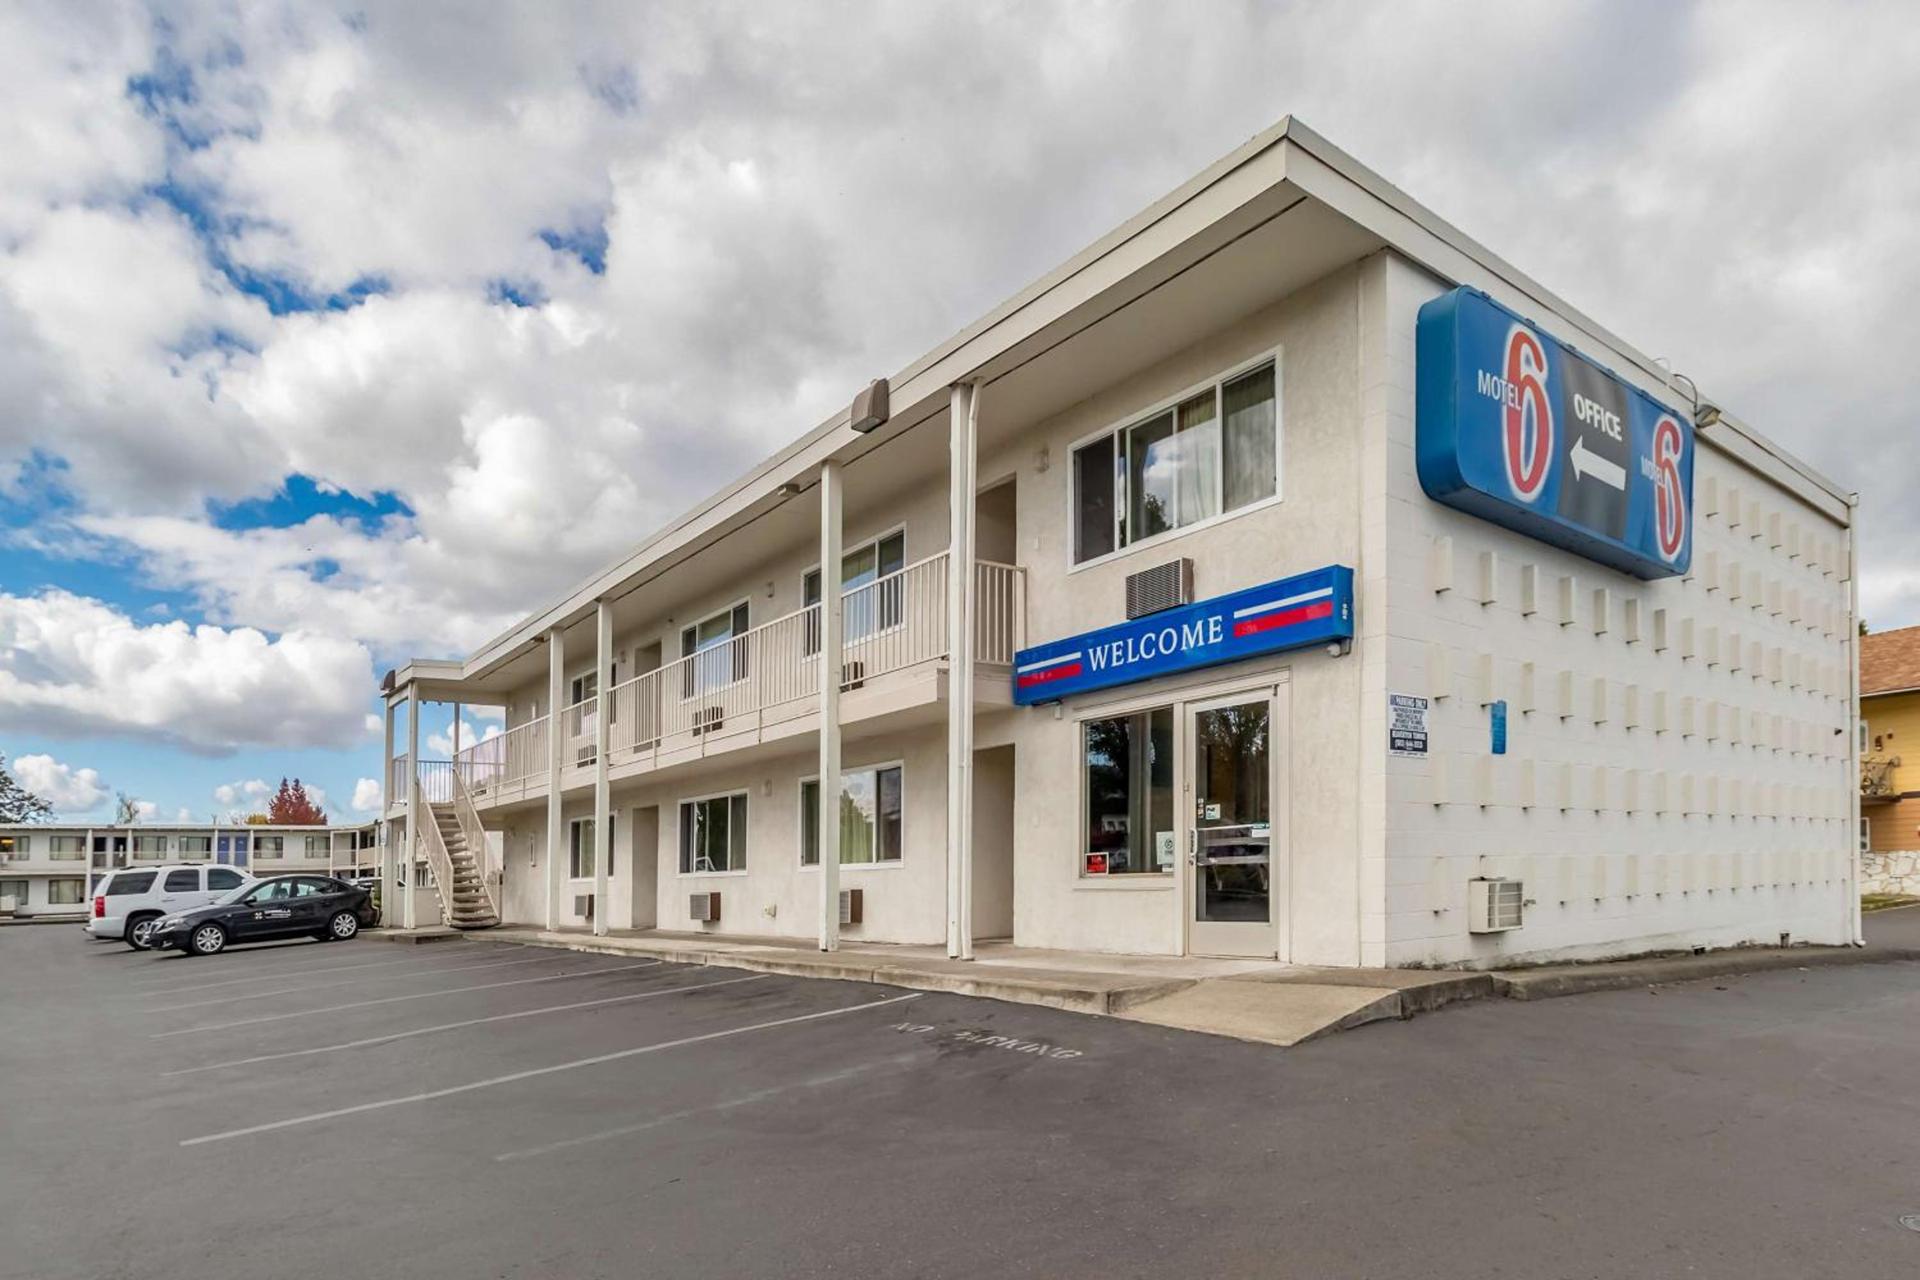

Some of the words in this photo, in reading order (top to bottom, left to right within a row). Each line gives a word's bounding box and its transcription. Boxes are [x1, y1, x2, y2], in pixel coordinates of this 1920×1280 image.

[1478, 369, 1521, 410] MOTEL
[1504, 327, 1554, 501] 6
[1574, 394, 1622, 441] OFFICE
[1654, 415, 1685, 563] 6
[1088, 615, 1224, 671] WELCOME
